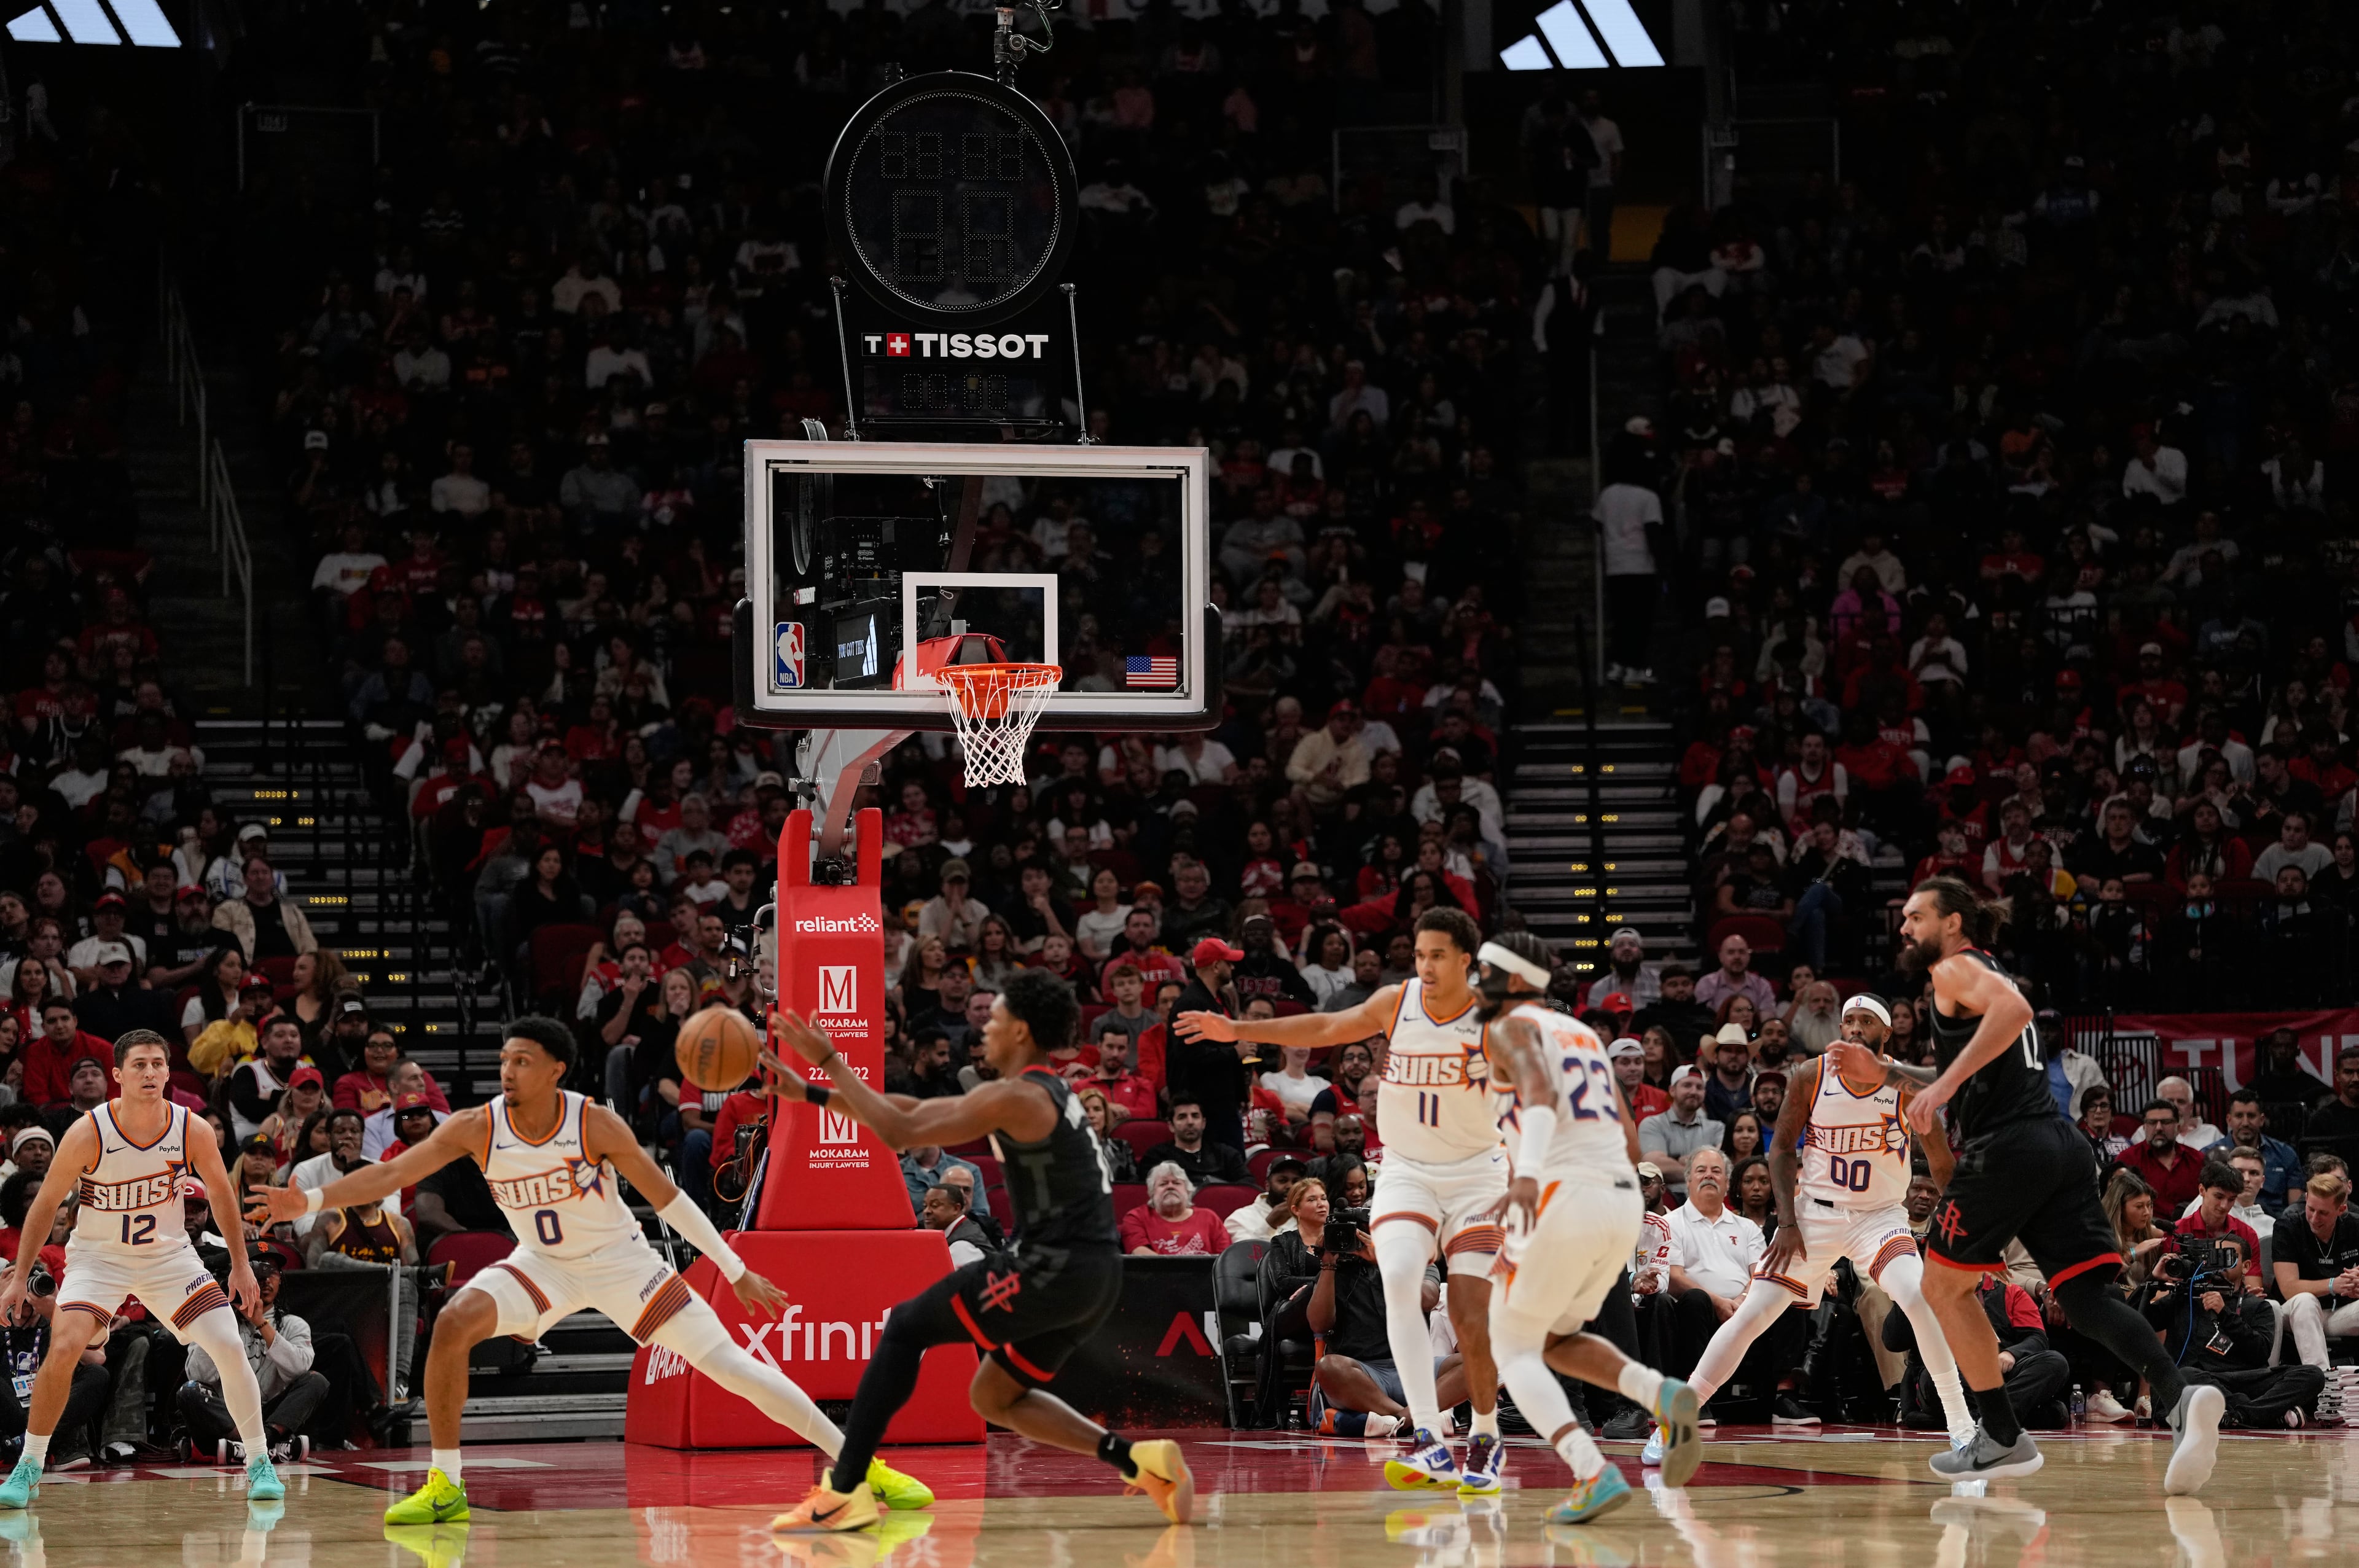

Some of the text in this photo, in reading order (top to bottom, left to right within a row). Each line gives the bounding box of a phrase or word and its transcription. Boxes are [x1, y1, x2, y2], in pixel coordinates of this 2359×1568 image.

[915, 333, 1049, 359] TISSOT
[855, 639, 864, 655] THIS
[780, 673, 793, 684] NBA
[796, 916, 858, 933] reliant
[823, 969, 853, 1010] M
[1454, 1026, 1476, 1036] PayPal
[1385, 1053, 1463, 1085] SUNS
[1562, 1057, 1621, 1123] 23
[1873, 1096, 1894, 1105] PayPal
[1419, 1091, 1439, 1128] 11
[554, 1139, 577, 1149] PayPal
[809, 1149, 869, 1158] MOKARAM
[1813, 1126, 1883, 1153] SUNS
[492, 1169, 572, 1209] SUNS
[1830, 1155, 1871, 1193] 00
[93, 1175, 170, 1210] SUNS
[122, 1214, 157, 1246] 12
[534, 1209, 563, 1246] 0
[186, 1273, 213, 1296] PHOENI
[639, 1266, 670, 1303] PHOENIX
[738, 1305, 892, 1371] xfini
